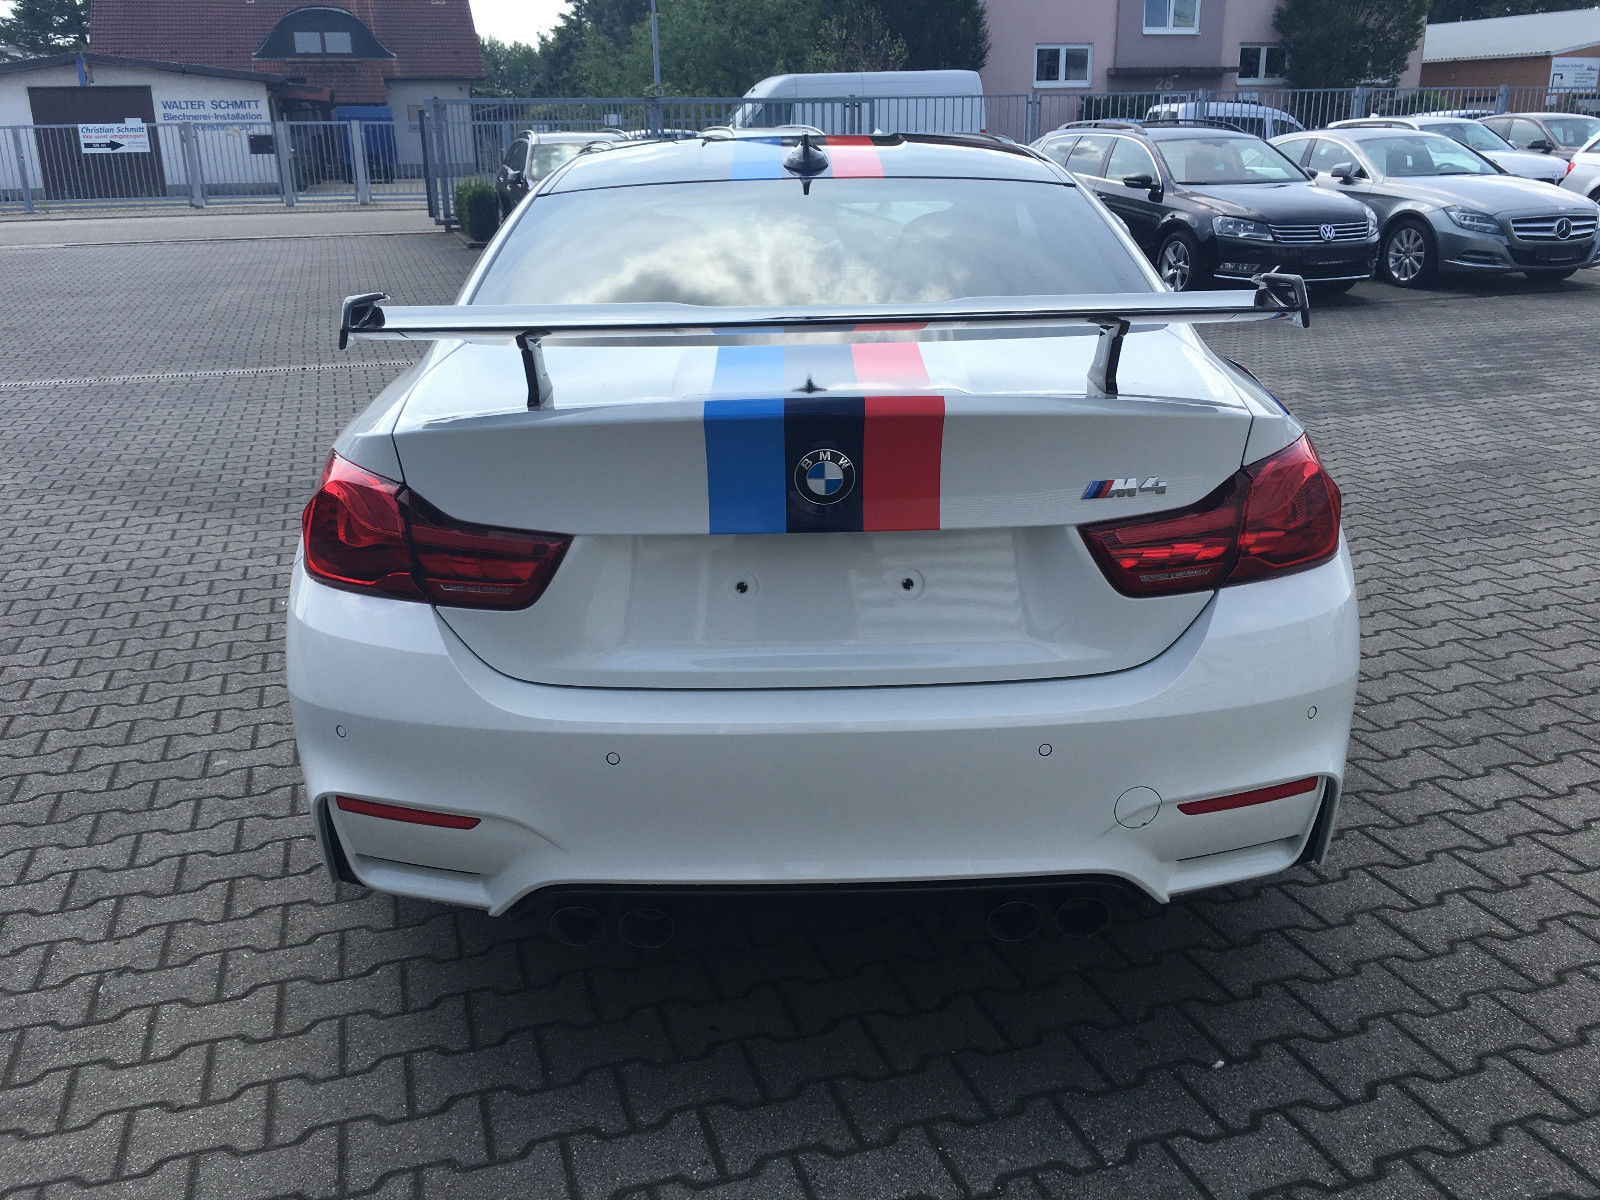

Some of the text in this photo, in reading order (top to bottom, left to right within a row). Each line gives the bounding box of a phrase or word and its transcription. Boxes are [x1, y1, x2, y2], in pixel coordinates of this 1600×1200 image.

[161, 99, 260, 110] WALTER SCHMITT
[162, 112, 262, 121] Blechnerei-Installation
[81, 126, 114, 134] Christian
[800, 450, 851, 471] BMW
[1103, 476, 1167, 498] M4
